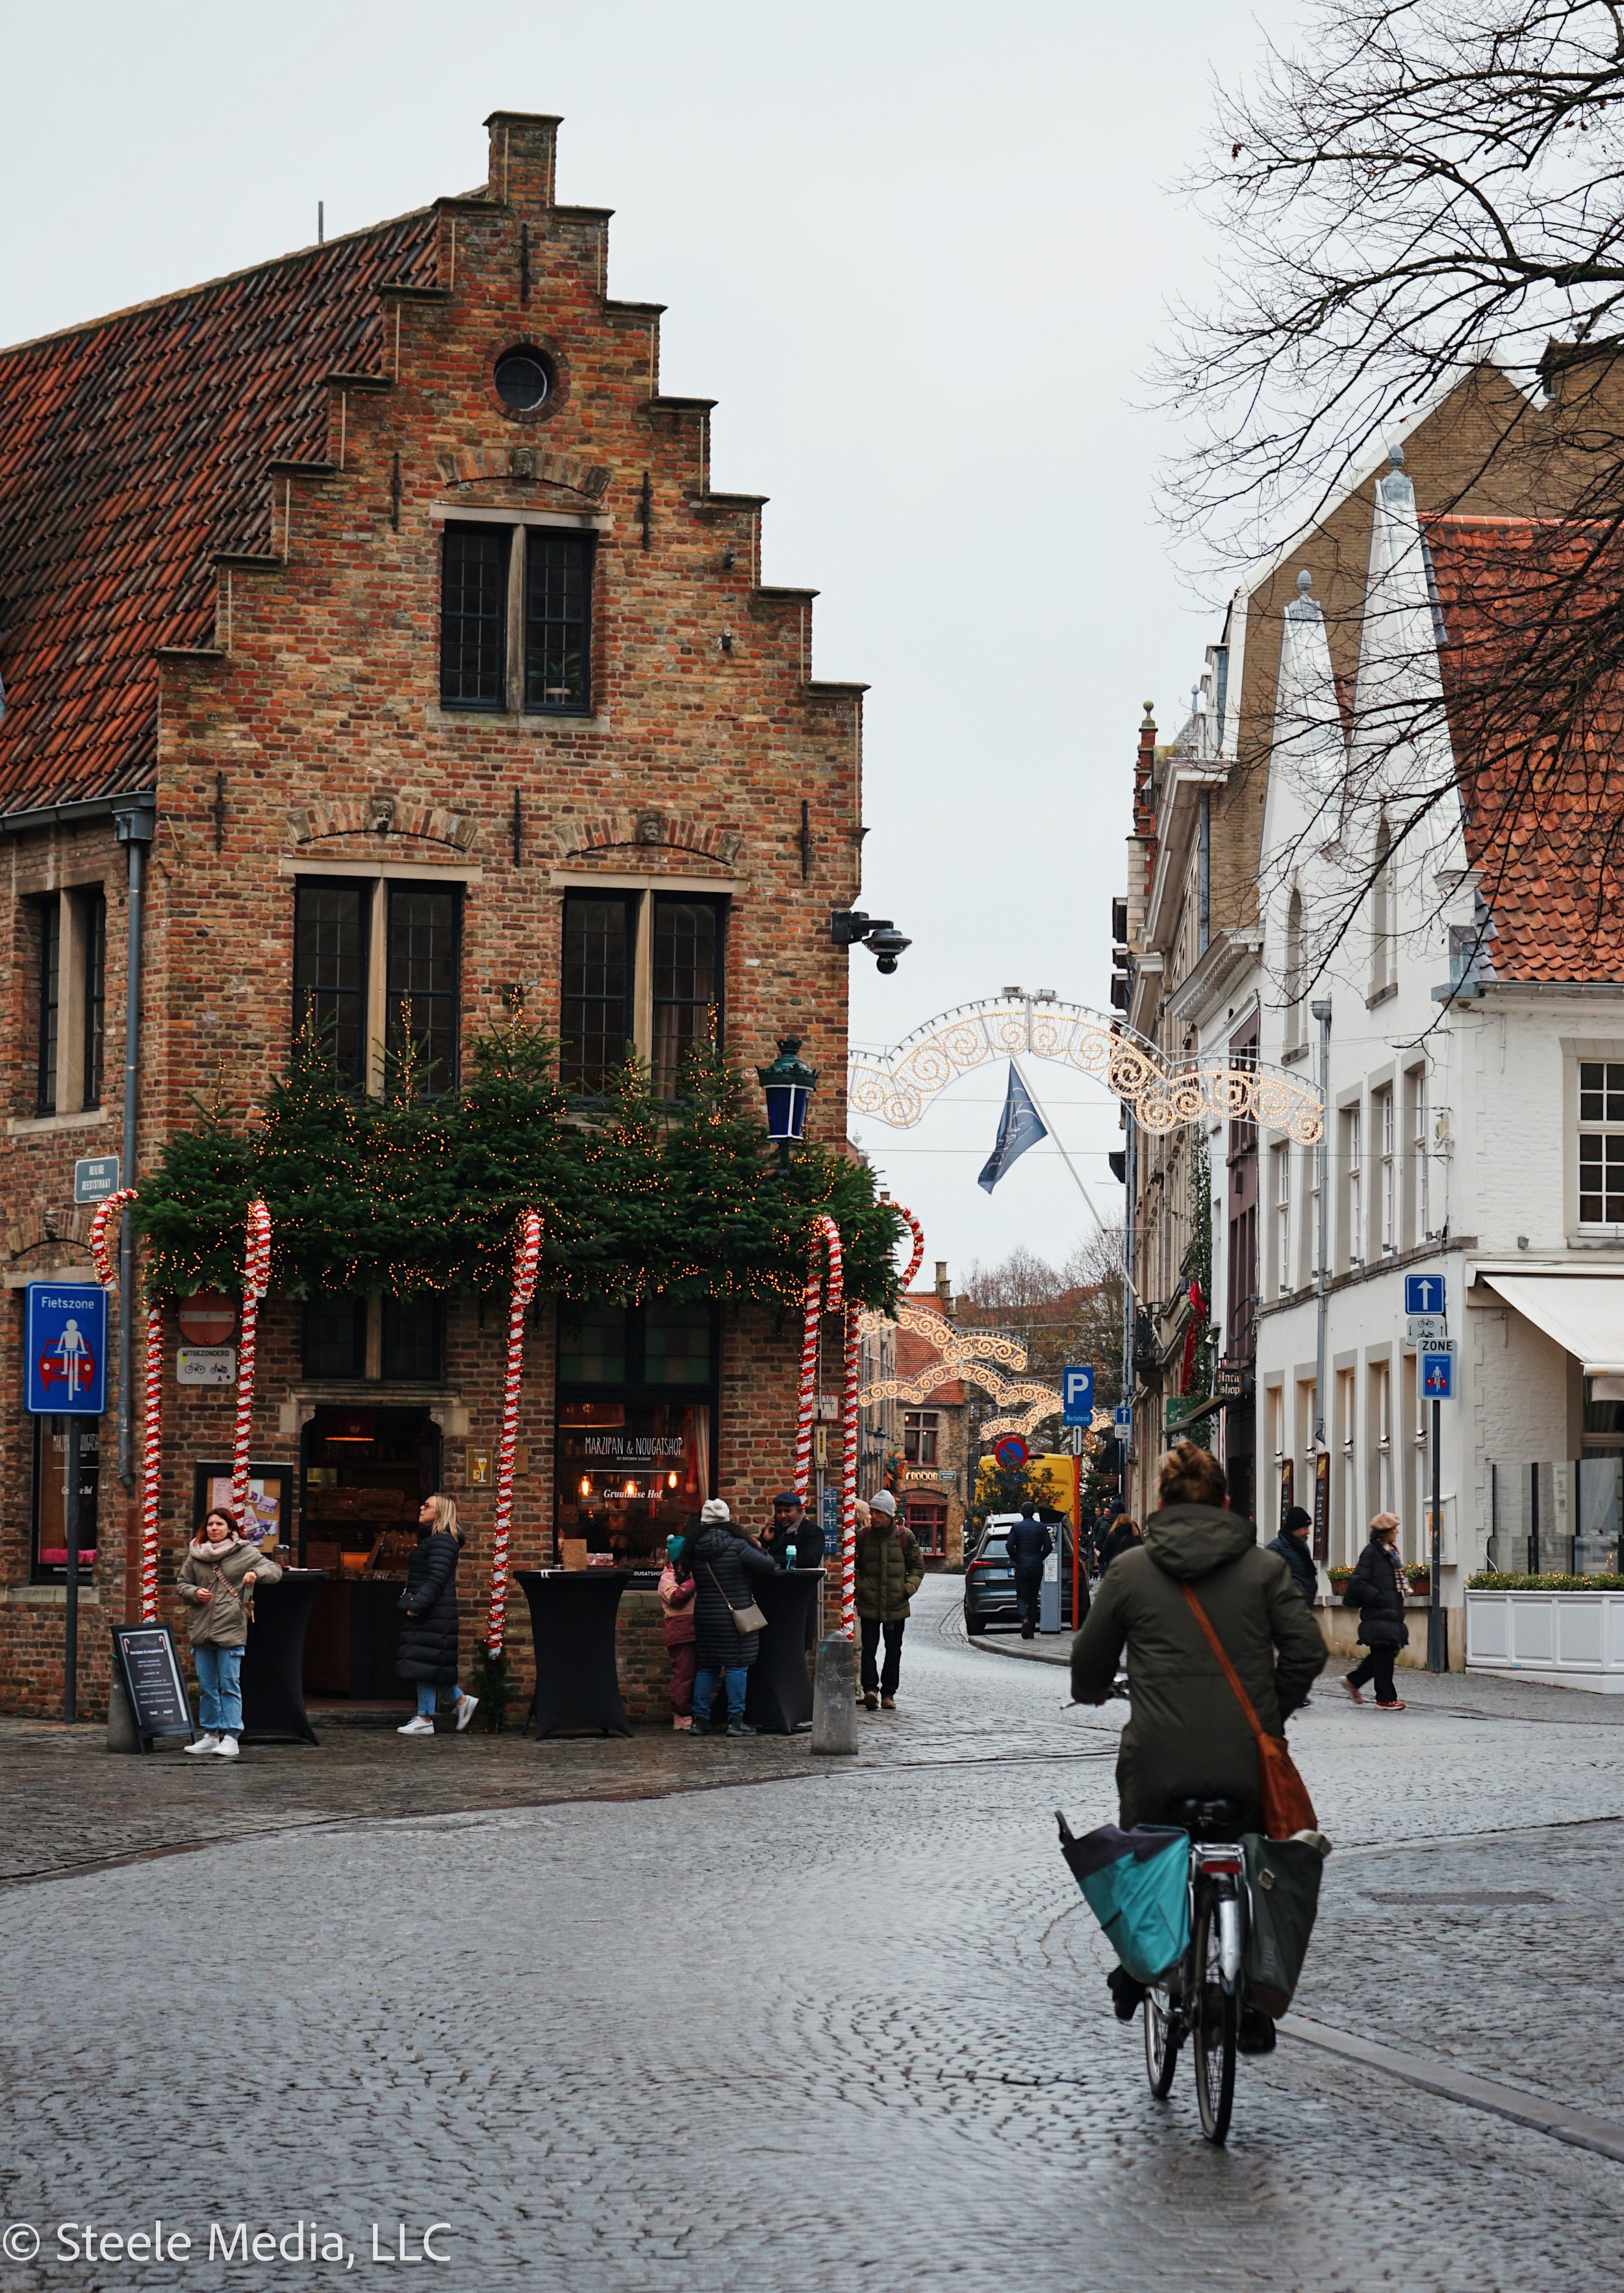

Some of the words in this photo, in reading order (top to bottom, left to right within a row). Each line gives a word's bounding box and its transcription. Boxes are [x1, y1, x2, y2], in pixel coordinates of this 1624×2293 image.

[42, 1296, 94, 1309] Fietszone
[1422, 1340, 1453, 1351] ZONE
[1067, 1374, 1089, 1403] P
[1220, 1383, 1240, 1397] shop
[585, 1437, 624, 1455] MARZIPAN
[626, 1441, 634, 1455] &
[636, 1437, 683, 1456] NOUGATSHOP
[647, 1490, 663, 1498] Hof
